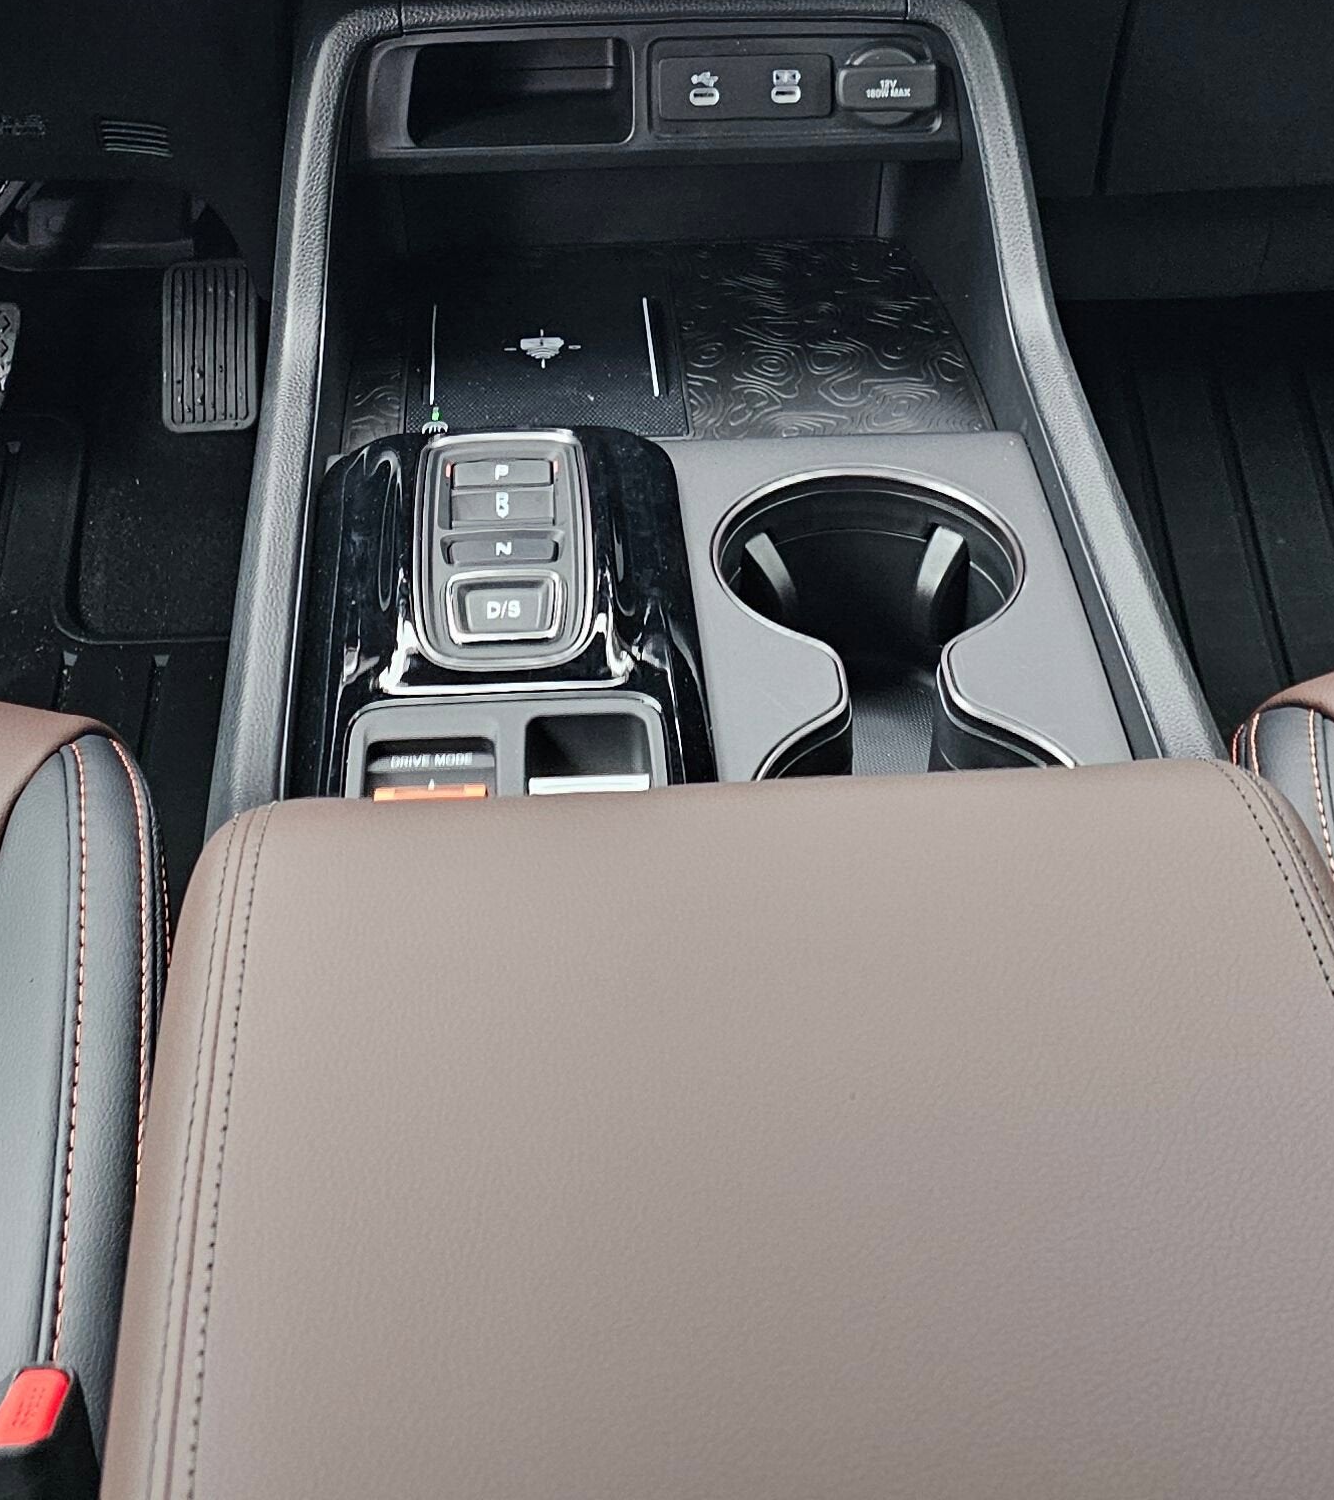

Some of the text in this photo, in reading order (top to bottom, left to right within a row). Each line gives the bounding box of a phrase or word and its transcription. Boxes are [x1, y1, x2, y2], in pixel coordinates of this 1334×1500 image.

[891, 88, 910, 98] MAX
[494, 464, 509, 481] P
[495, 541, 512, 556] N
[487, 600, 521, 619] D/S
[390, 752, 473, 769] DRIVE MODE
